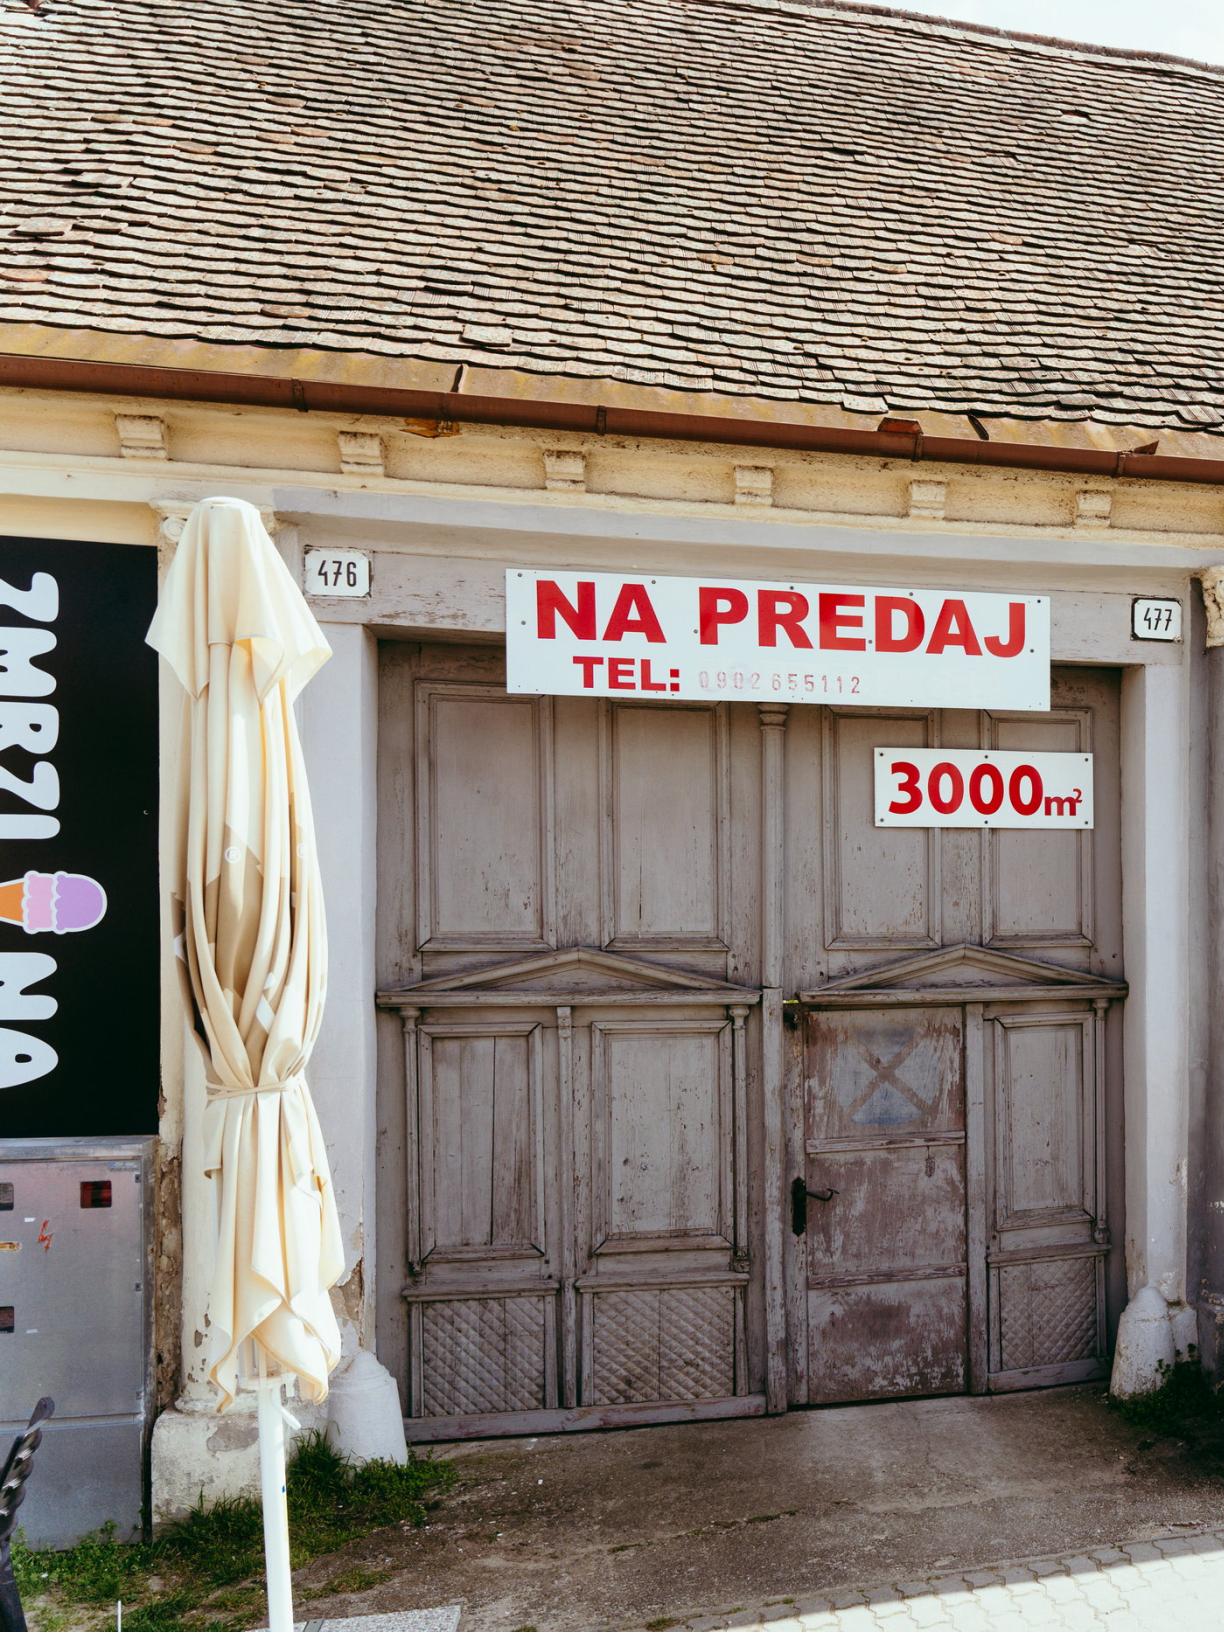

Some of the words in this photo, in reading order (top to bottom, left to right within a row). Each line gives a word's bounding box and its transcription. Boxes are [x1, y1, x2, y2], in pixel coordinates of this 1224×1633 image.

[318, 560, 357, 587] 476
[536, 580, 667, 643] NA
[698, 587, 1026, 658] PREDAJ
[1143, 607, 1173, 631] 477
[572, 656, 681, 693] TEL:
[699, 671, 761, 691] 0902
[771, 673, 861, 695] 655112
